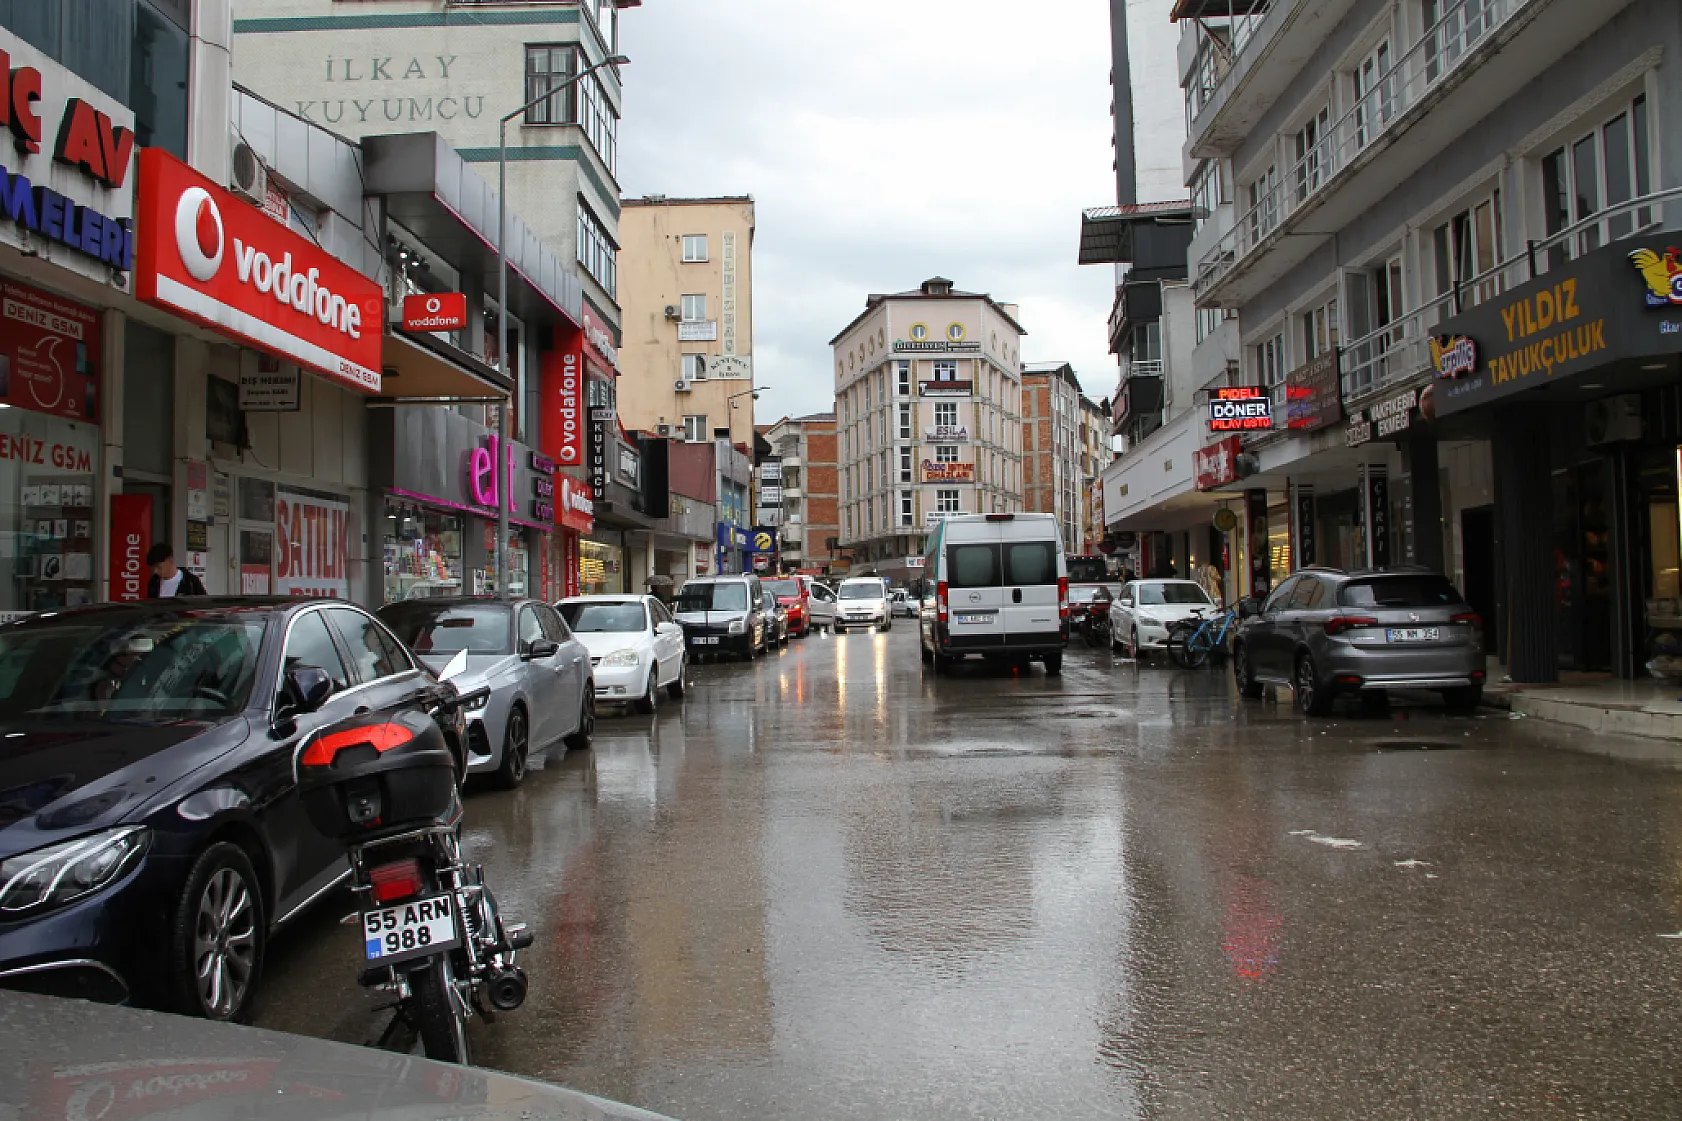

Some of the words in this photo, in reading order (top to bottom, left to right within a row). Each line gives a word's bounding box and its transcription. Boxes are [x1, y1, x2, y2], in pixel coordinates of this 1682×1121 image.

[325, 54, 458, 82] İLKAY
[295, 95, 484, 124] KUYUMCU
[54, 98, 135, 188] AV
[233, 238, 361, 338] vodafone
[408, 315, 459, 327] vodafone
[1501, 277, 1580, 342] YILDIZ
[52, 318, 80, 337] GSM
[1488, 319, 1606, 386] TAVUKÇULUK
[559, 354, 577, 444] vodafone
[1213, 401, 1267, 418] DÖNER
[52, 442, 92, 472] GSM
[277, 499, 348, 578] SATILIK
[367, 910, 398, 934] 55
[404, 898, 450, 926] ARN
[386, 927, 432, 953] 988
